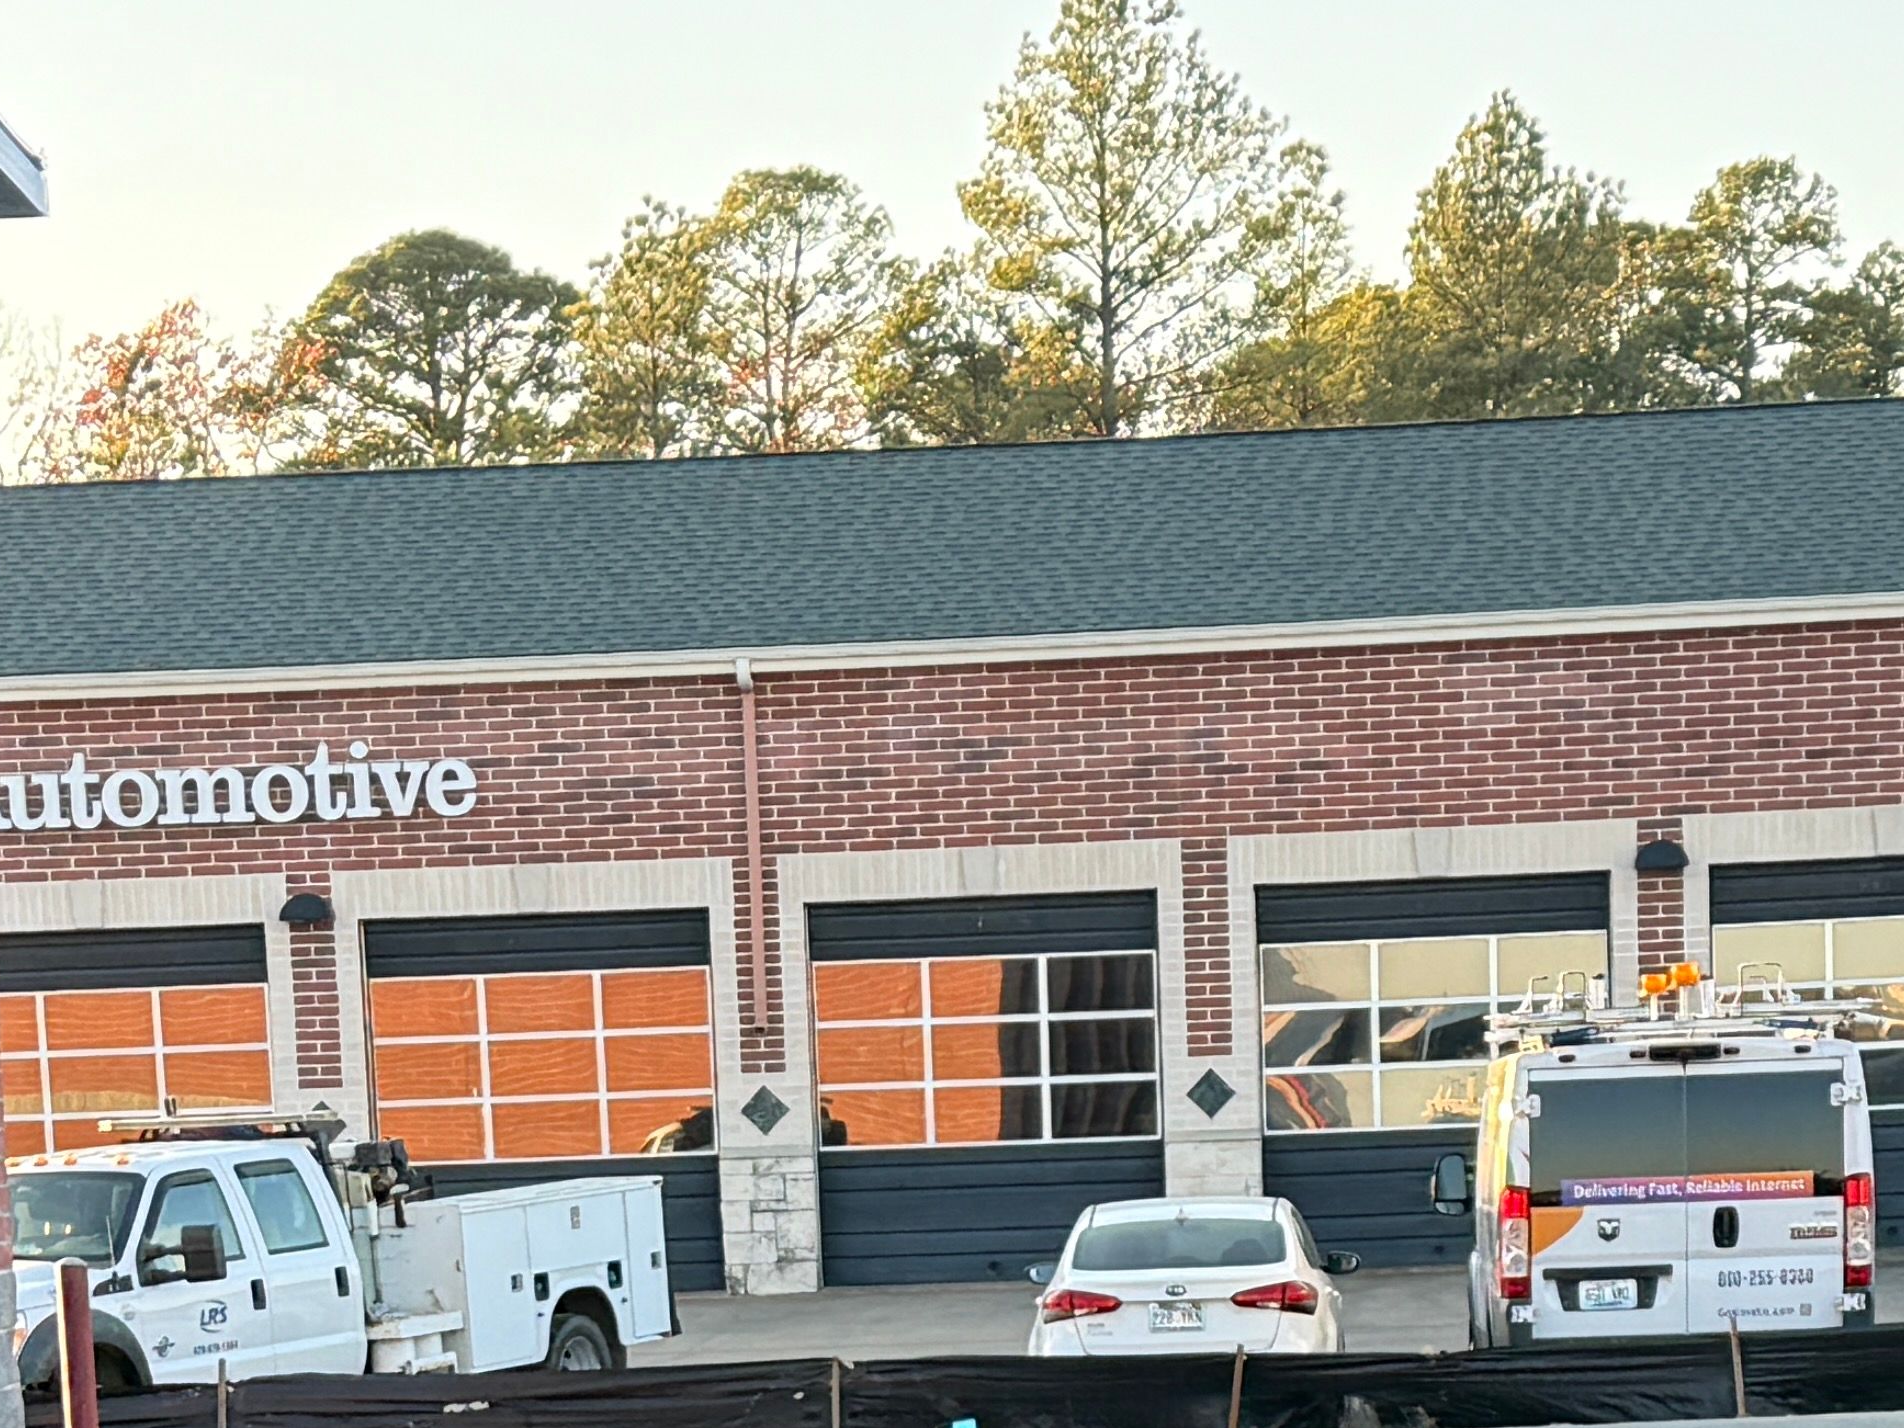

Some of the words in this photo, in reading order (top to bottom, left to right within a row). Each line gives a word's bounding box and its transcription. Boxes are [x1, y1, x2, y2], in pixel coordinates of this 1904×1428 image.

[1573, 1183, 1645, 1199] Delivering
[1686, 1180, 1743, 1195] Reliable
[1746, 1178, 1806, 1193] Internet
[199, 1305, 228, 1326] LRS
